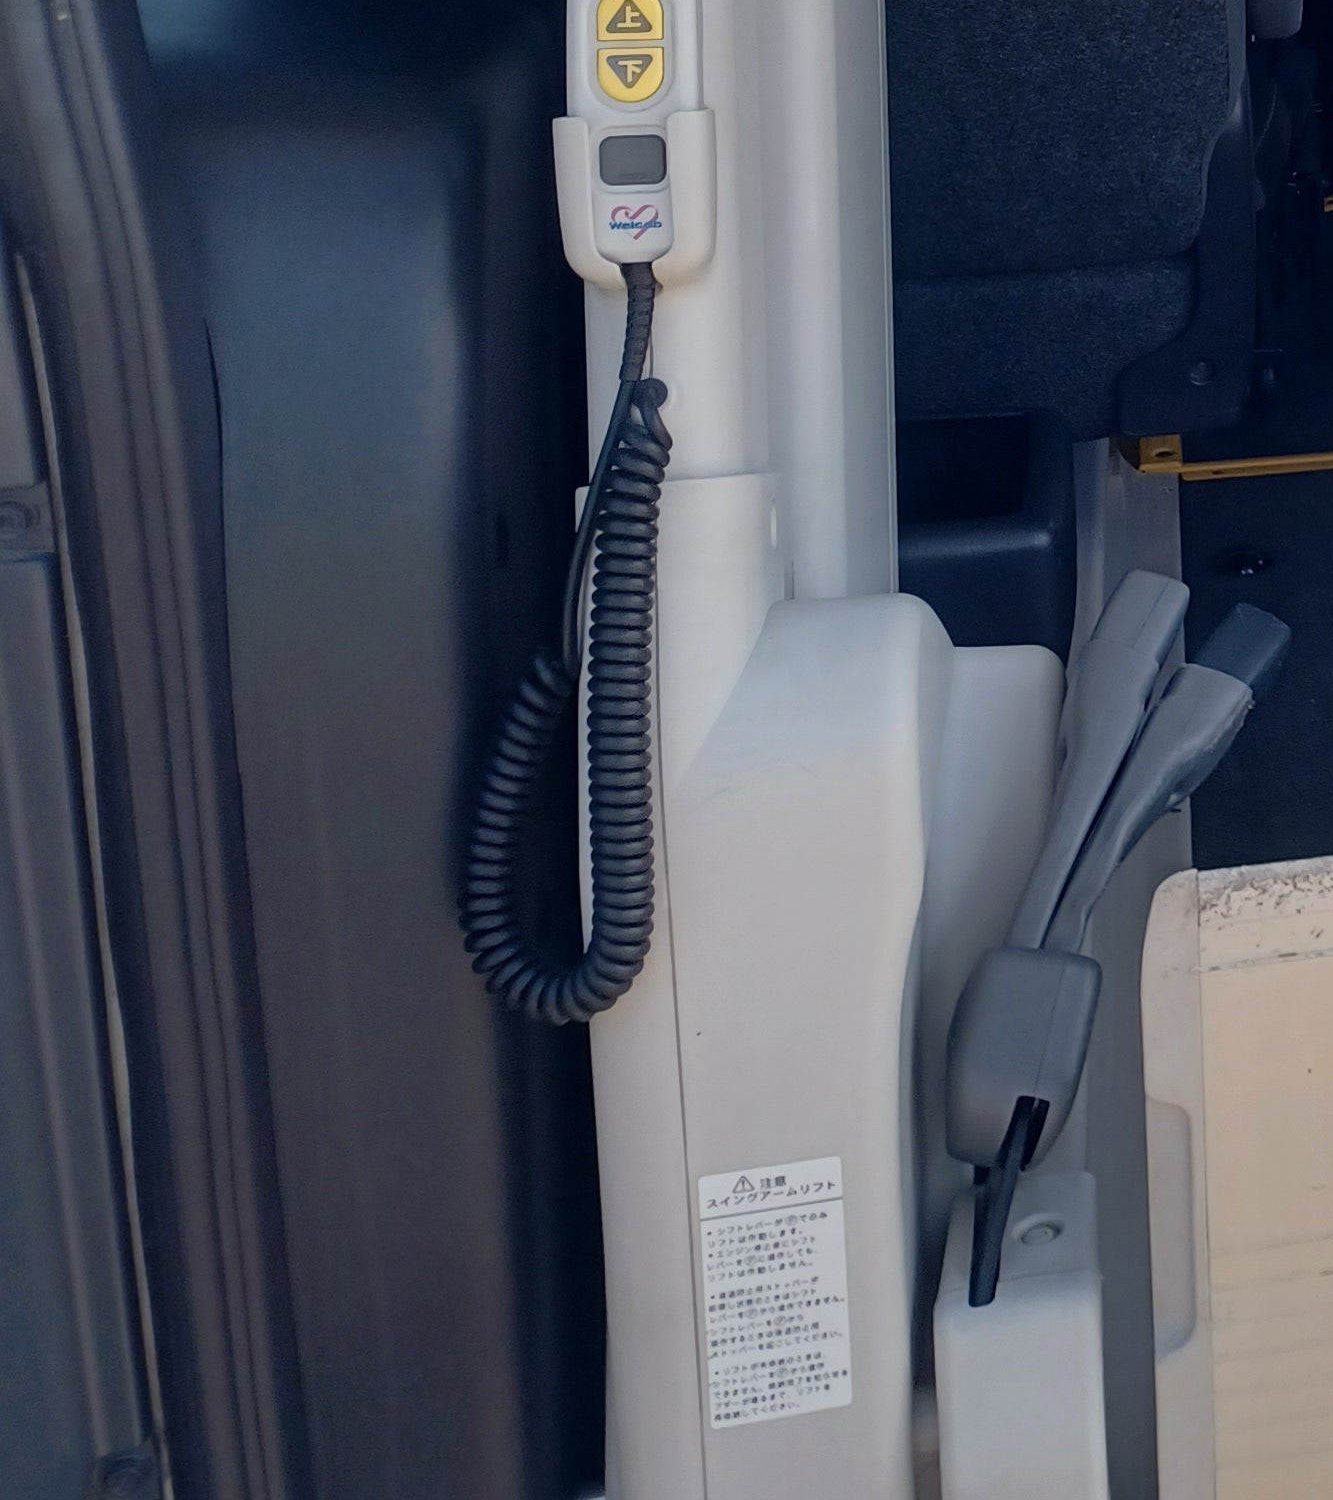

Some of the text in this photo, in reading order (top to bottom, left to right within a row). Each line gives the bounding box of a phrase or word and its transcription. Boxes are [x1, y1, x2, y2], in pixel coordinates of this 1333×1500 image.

[616, 4, 642, 29] 上
[617, 59, 644, 83] 下
[608, 218, 664, 231] Welcab
[759, 1175, 787, 1189] 注意
[707, 1181, 837, 1209] スイングアームリフト
